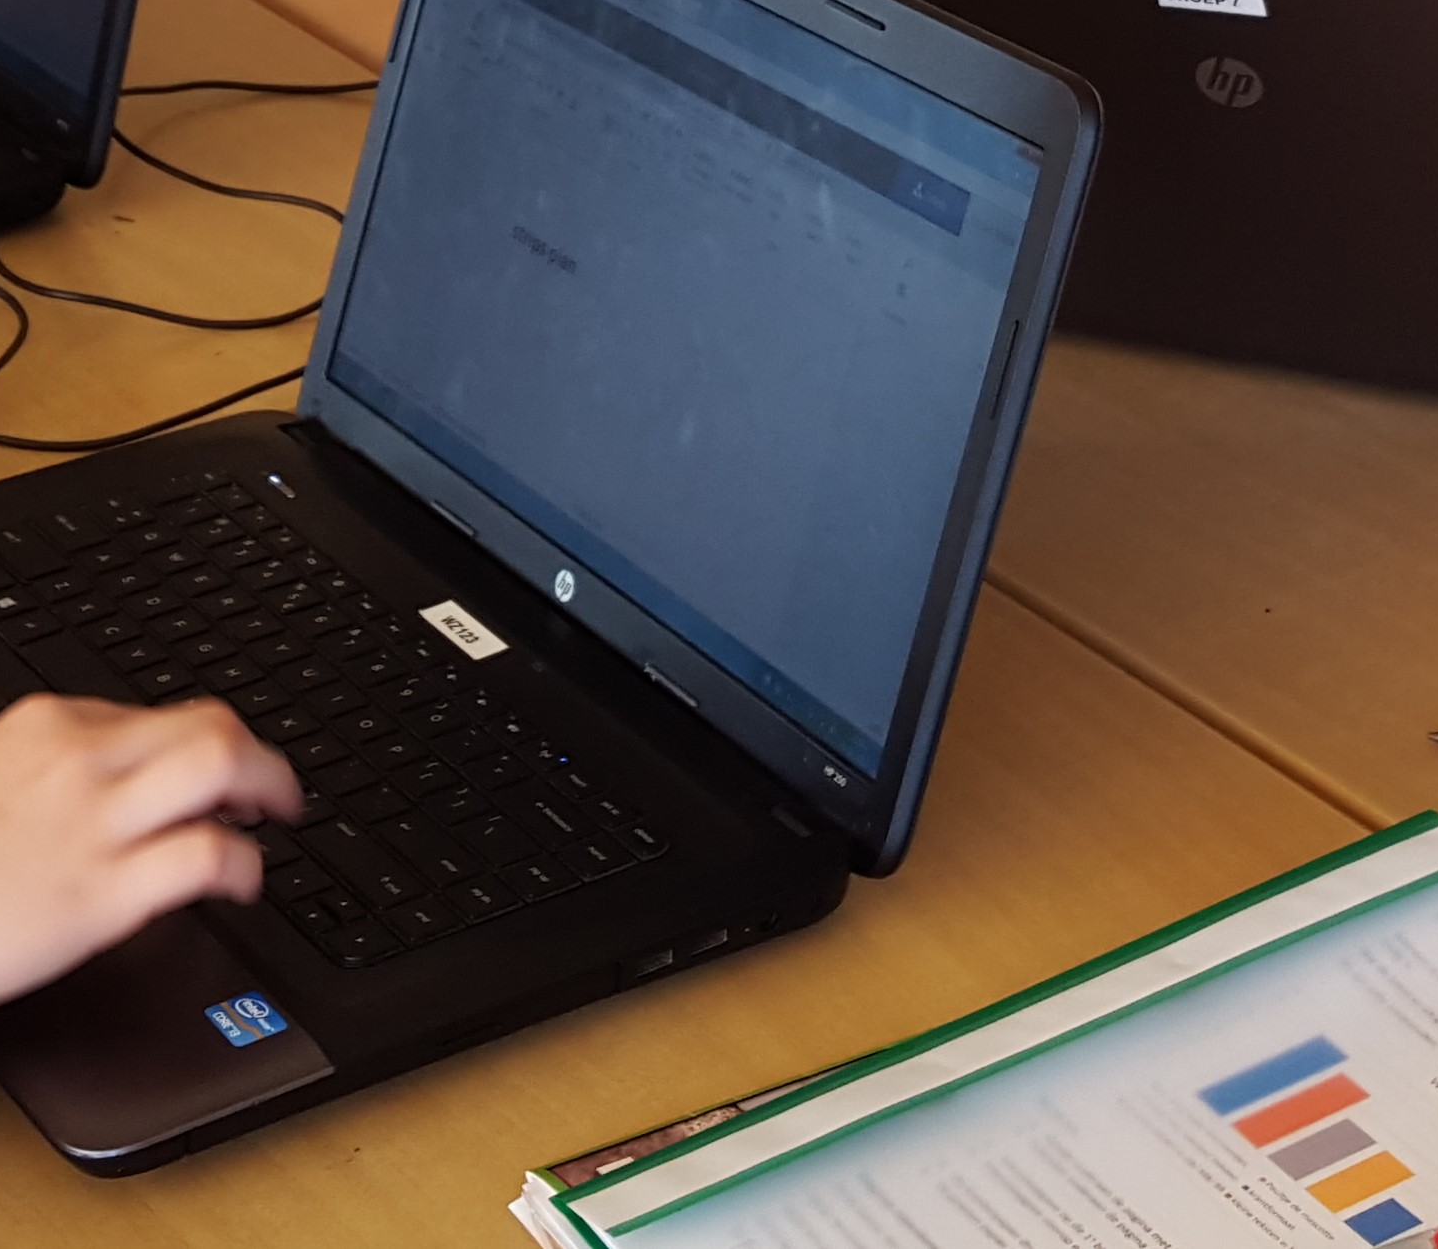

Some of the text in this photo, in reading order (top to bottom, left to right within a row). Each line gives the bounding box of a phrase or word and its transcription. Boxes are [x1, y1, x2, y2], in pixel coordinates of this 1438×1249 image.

[1197, 55, 1261, 107] hp
[555, 569, 574, 602] hp
[441, 615, 480, 644] WZ123
